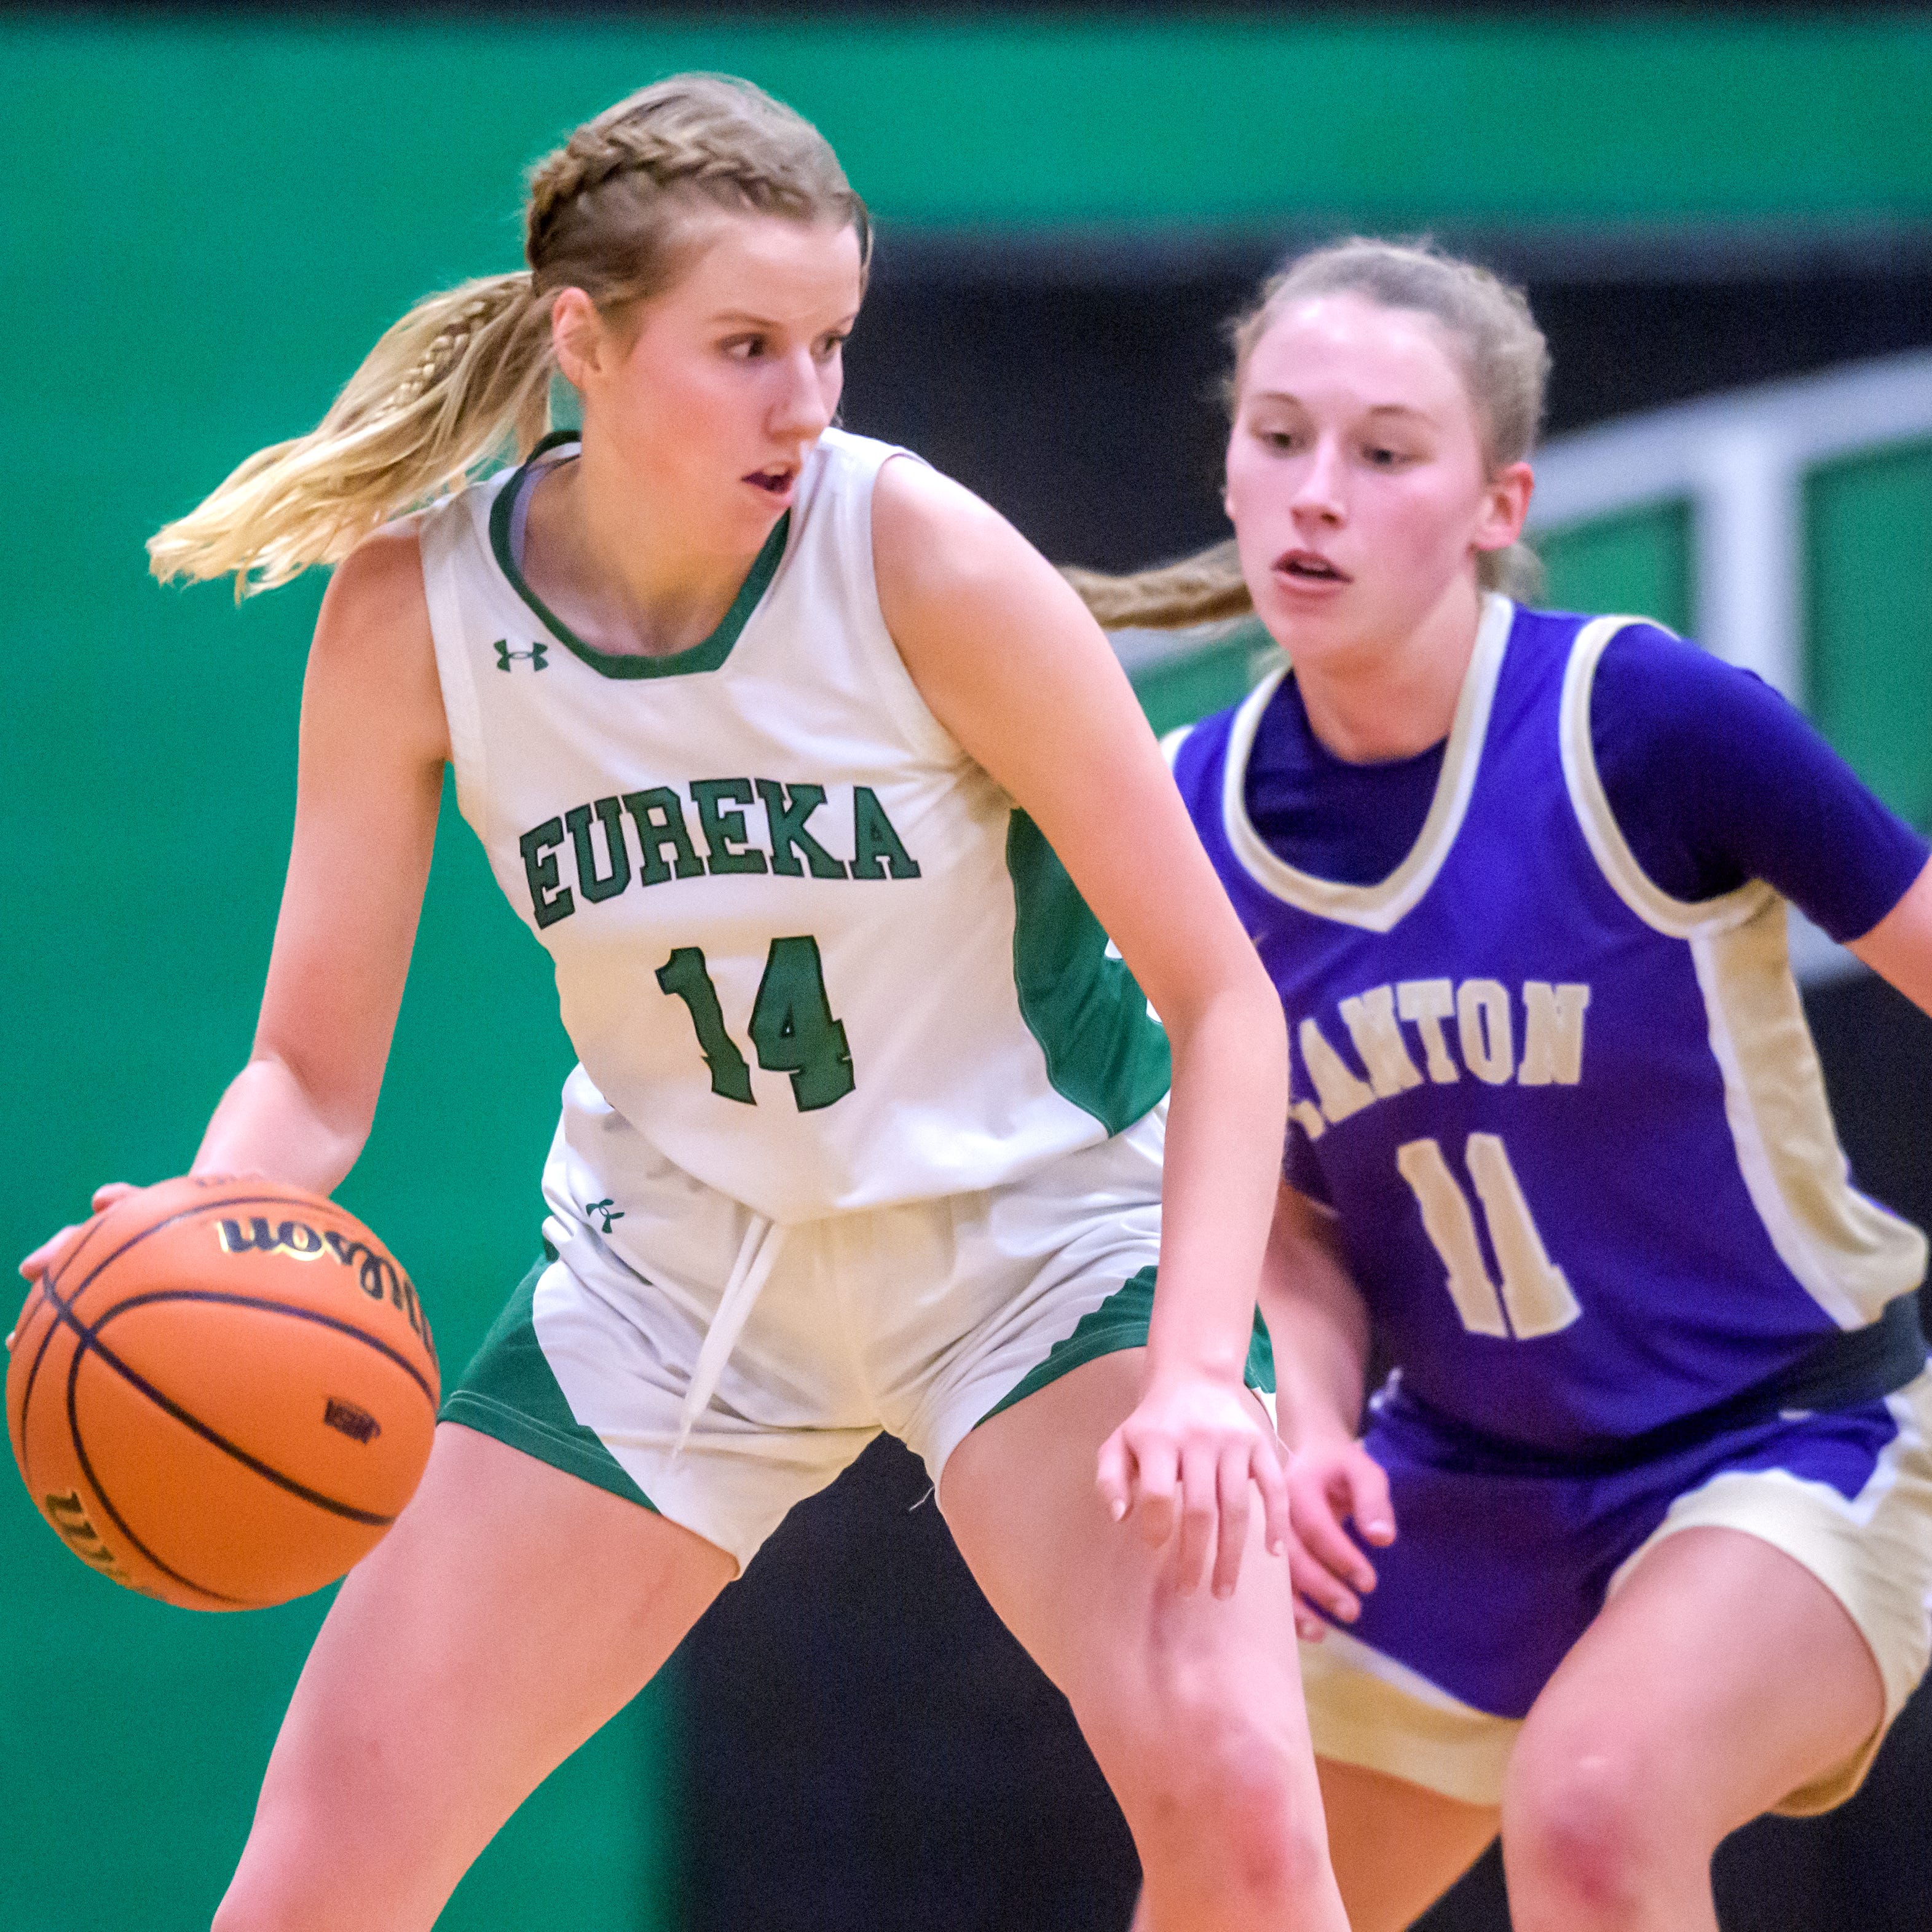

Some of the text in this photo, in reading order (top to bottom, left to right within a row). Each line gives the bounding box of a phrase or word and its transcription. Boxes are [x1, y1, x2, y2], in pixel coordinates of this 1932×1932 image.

[519, 777, 922, 930] EUREKA
[655, 935, 856, 1113] 14
[1288, 979, 1592, 1140] ANTON
[1397, 1132, 1583, 1340] 11
